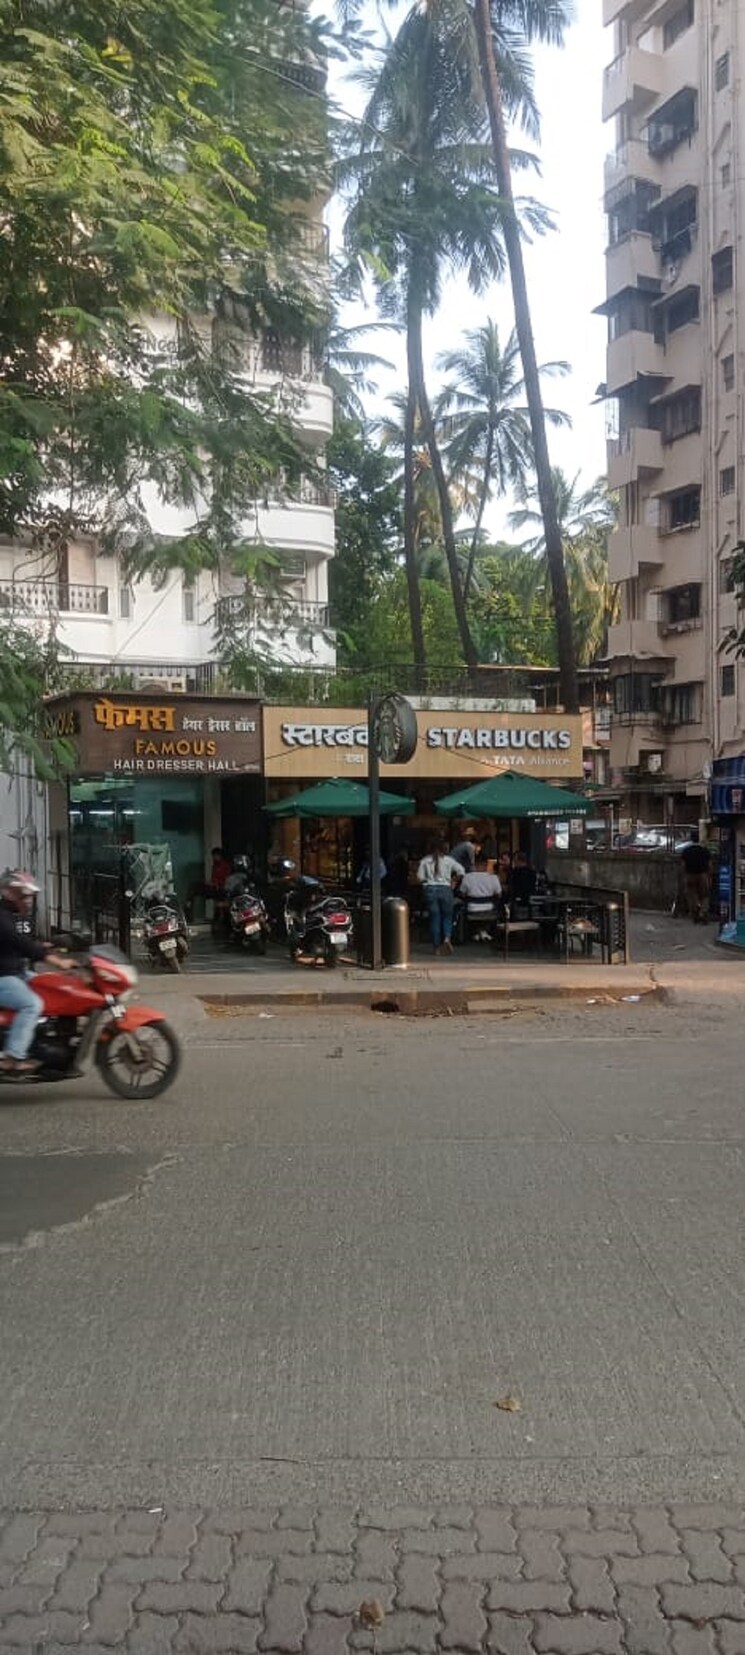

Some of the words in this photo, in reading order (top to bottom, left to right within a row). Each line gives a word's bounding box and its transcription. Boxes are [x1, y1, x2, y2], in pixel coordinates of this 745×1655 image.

[94, 697, 176, 731] फेमस
[427, 727, 572, 748] STARBUCKS
[136, 738, 218, 757] FAMOUS
[113, 759, 144, 770] HAIR
[146, 759, 205, 771] DRESSER
[207, 760, 241, 771] HALL
[493, 755, 525, 766] TATA
